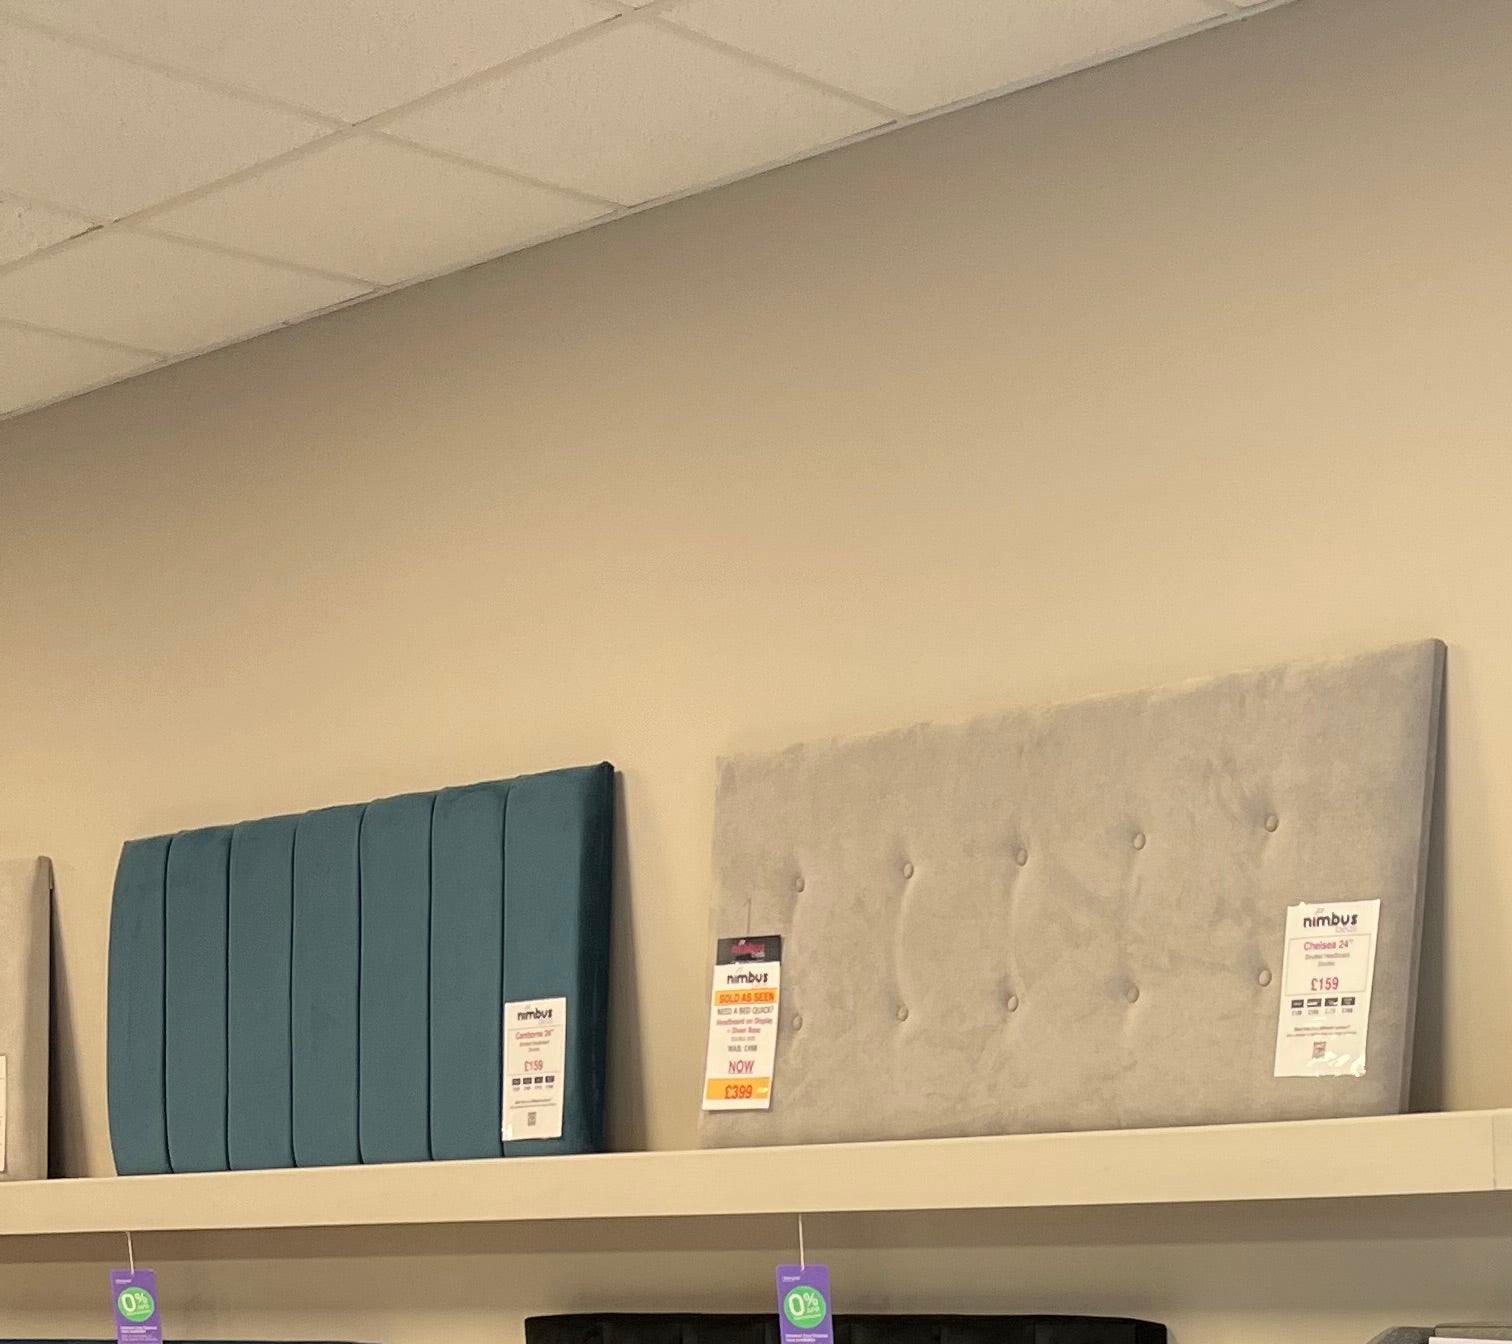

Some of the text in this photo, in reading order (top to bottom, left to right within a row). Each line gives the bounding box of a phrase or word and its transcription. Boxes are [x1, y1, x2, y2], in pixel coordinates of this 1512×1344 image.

[1303, 912, 1358, 928] nimbus
[1304, 941, 1336, 951] Chelsea
[727, 972, 768, 984] nimbus
[1311, 976, 1339, 991] £159
[720, 992, 774, 1003] SOLD AS SEEN
[517, 1008, 552, 1021] nimbus
[524, 1060, 543, 1071] £159
[728, 1060, 754, 1073] NOW
[724, 1085, 752, 1099] £399
[121, 1292, 148, 1312] 0%
[788, 1292, 818, 1316] 0%
